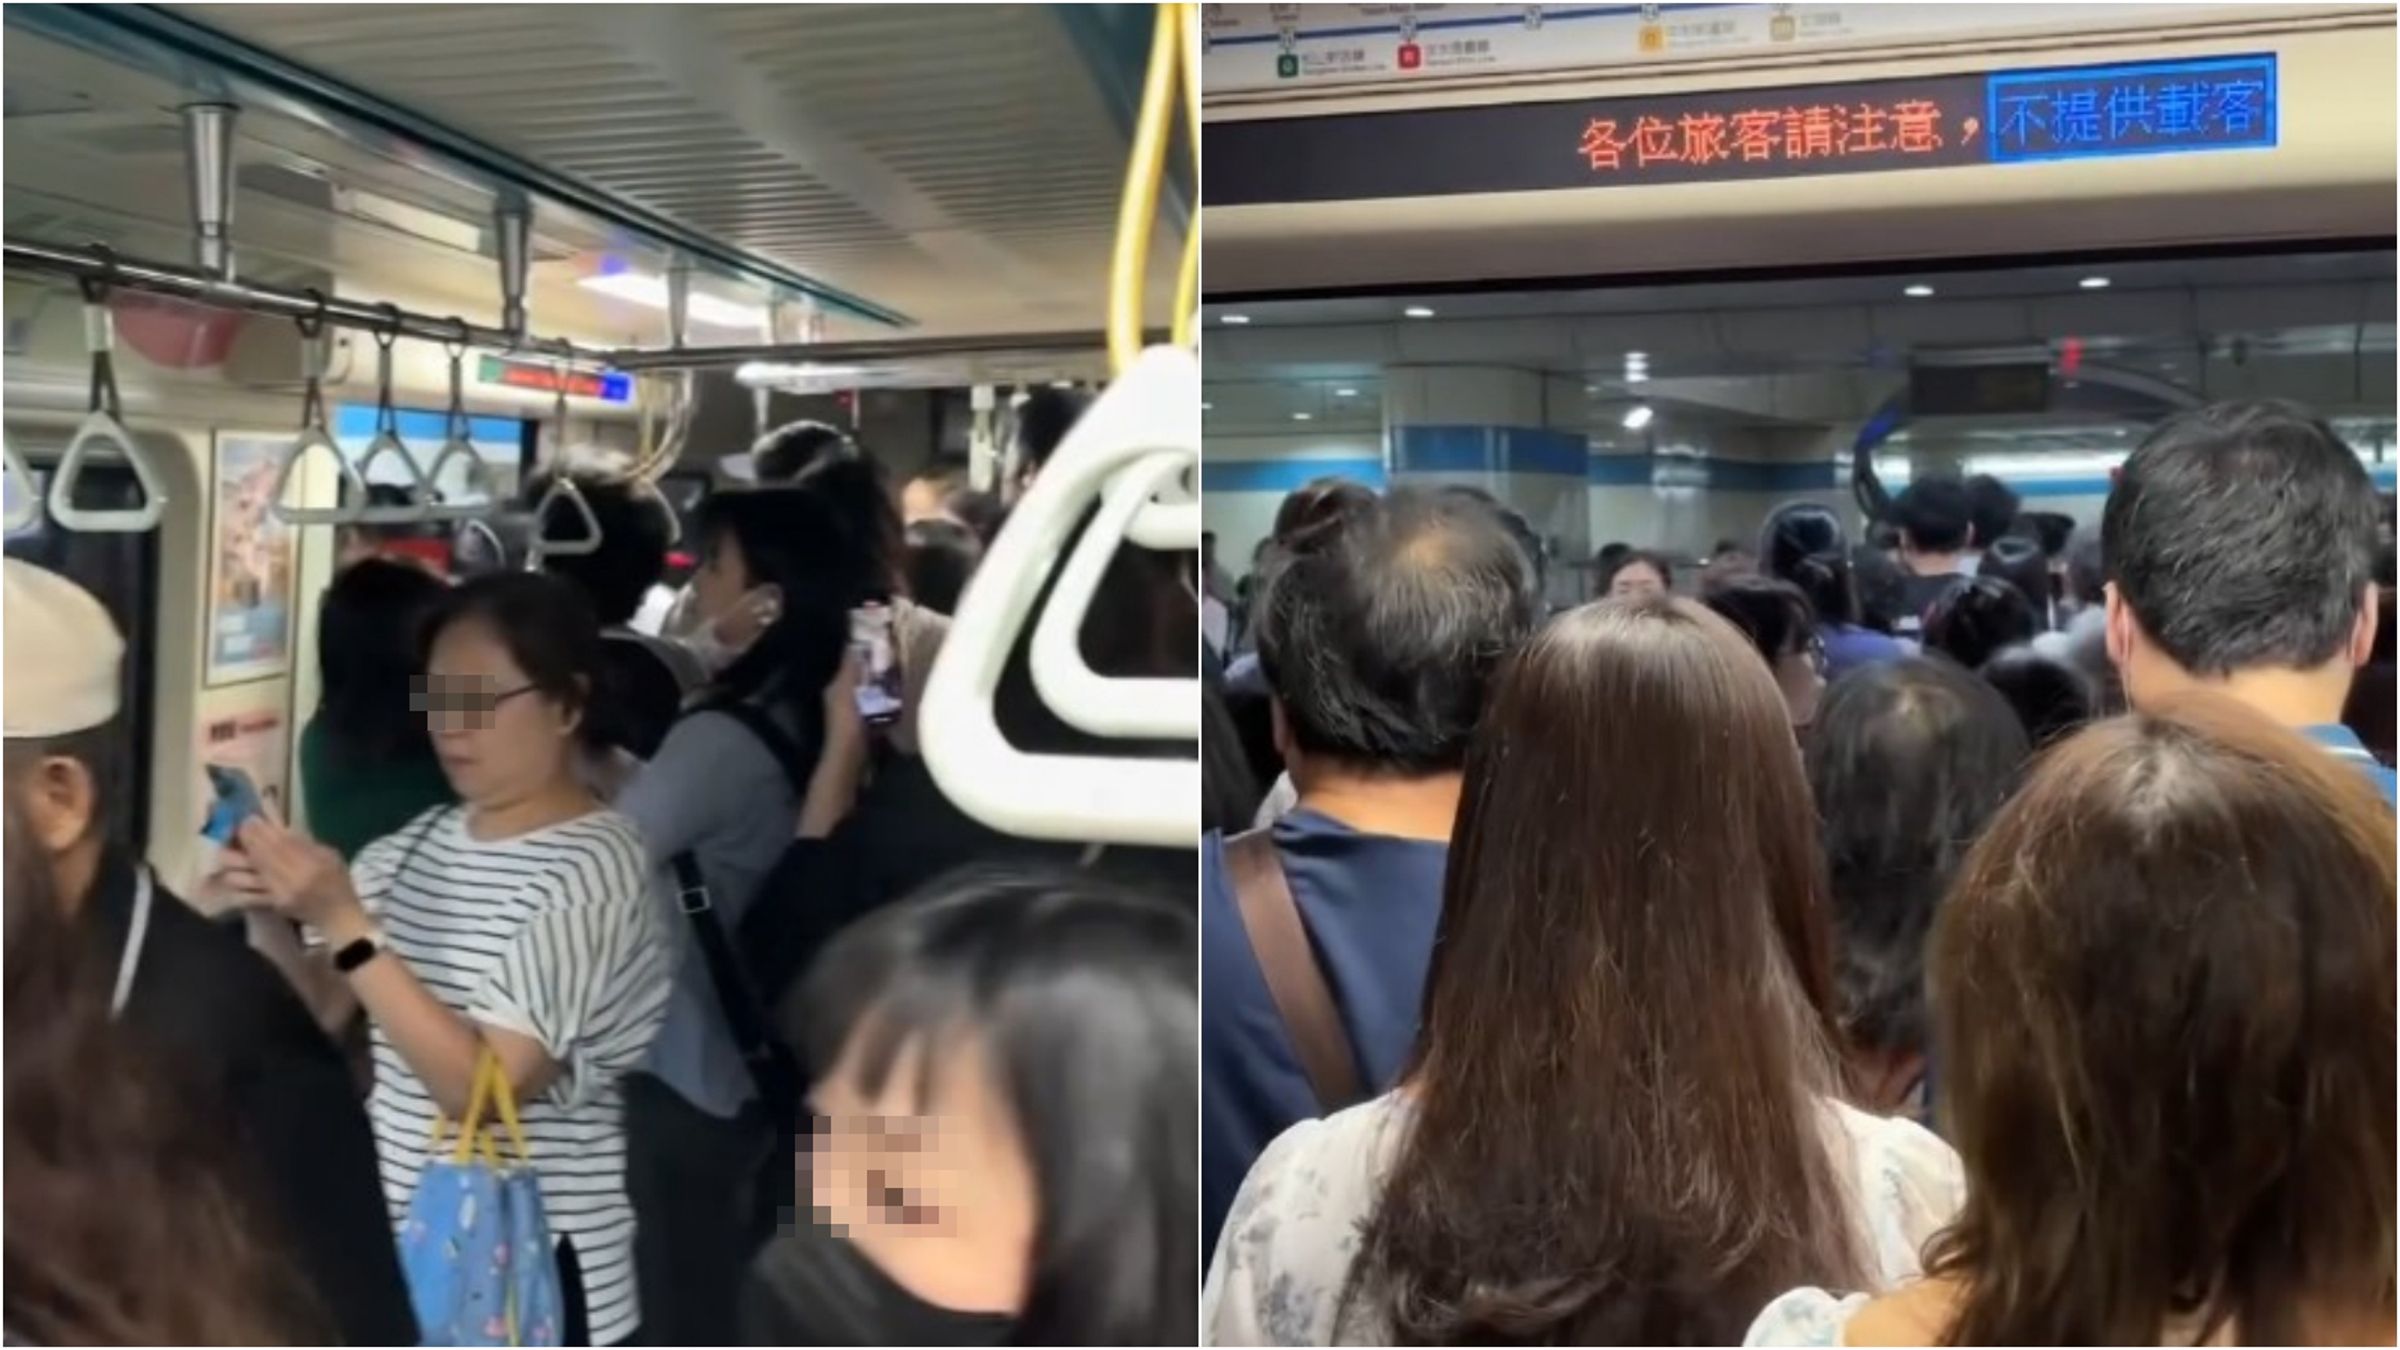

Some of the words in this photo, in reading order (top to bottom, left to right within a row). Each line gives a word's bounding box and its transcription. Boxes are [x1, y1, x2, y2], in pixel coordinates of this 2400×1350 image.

[1998, 79, 2264, 146] 不提供載客
